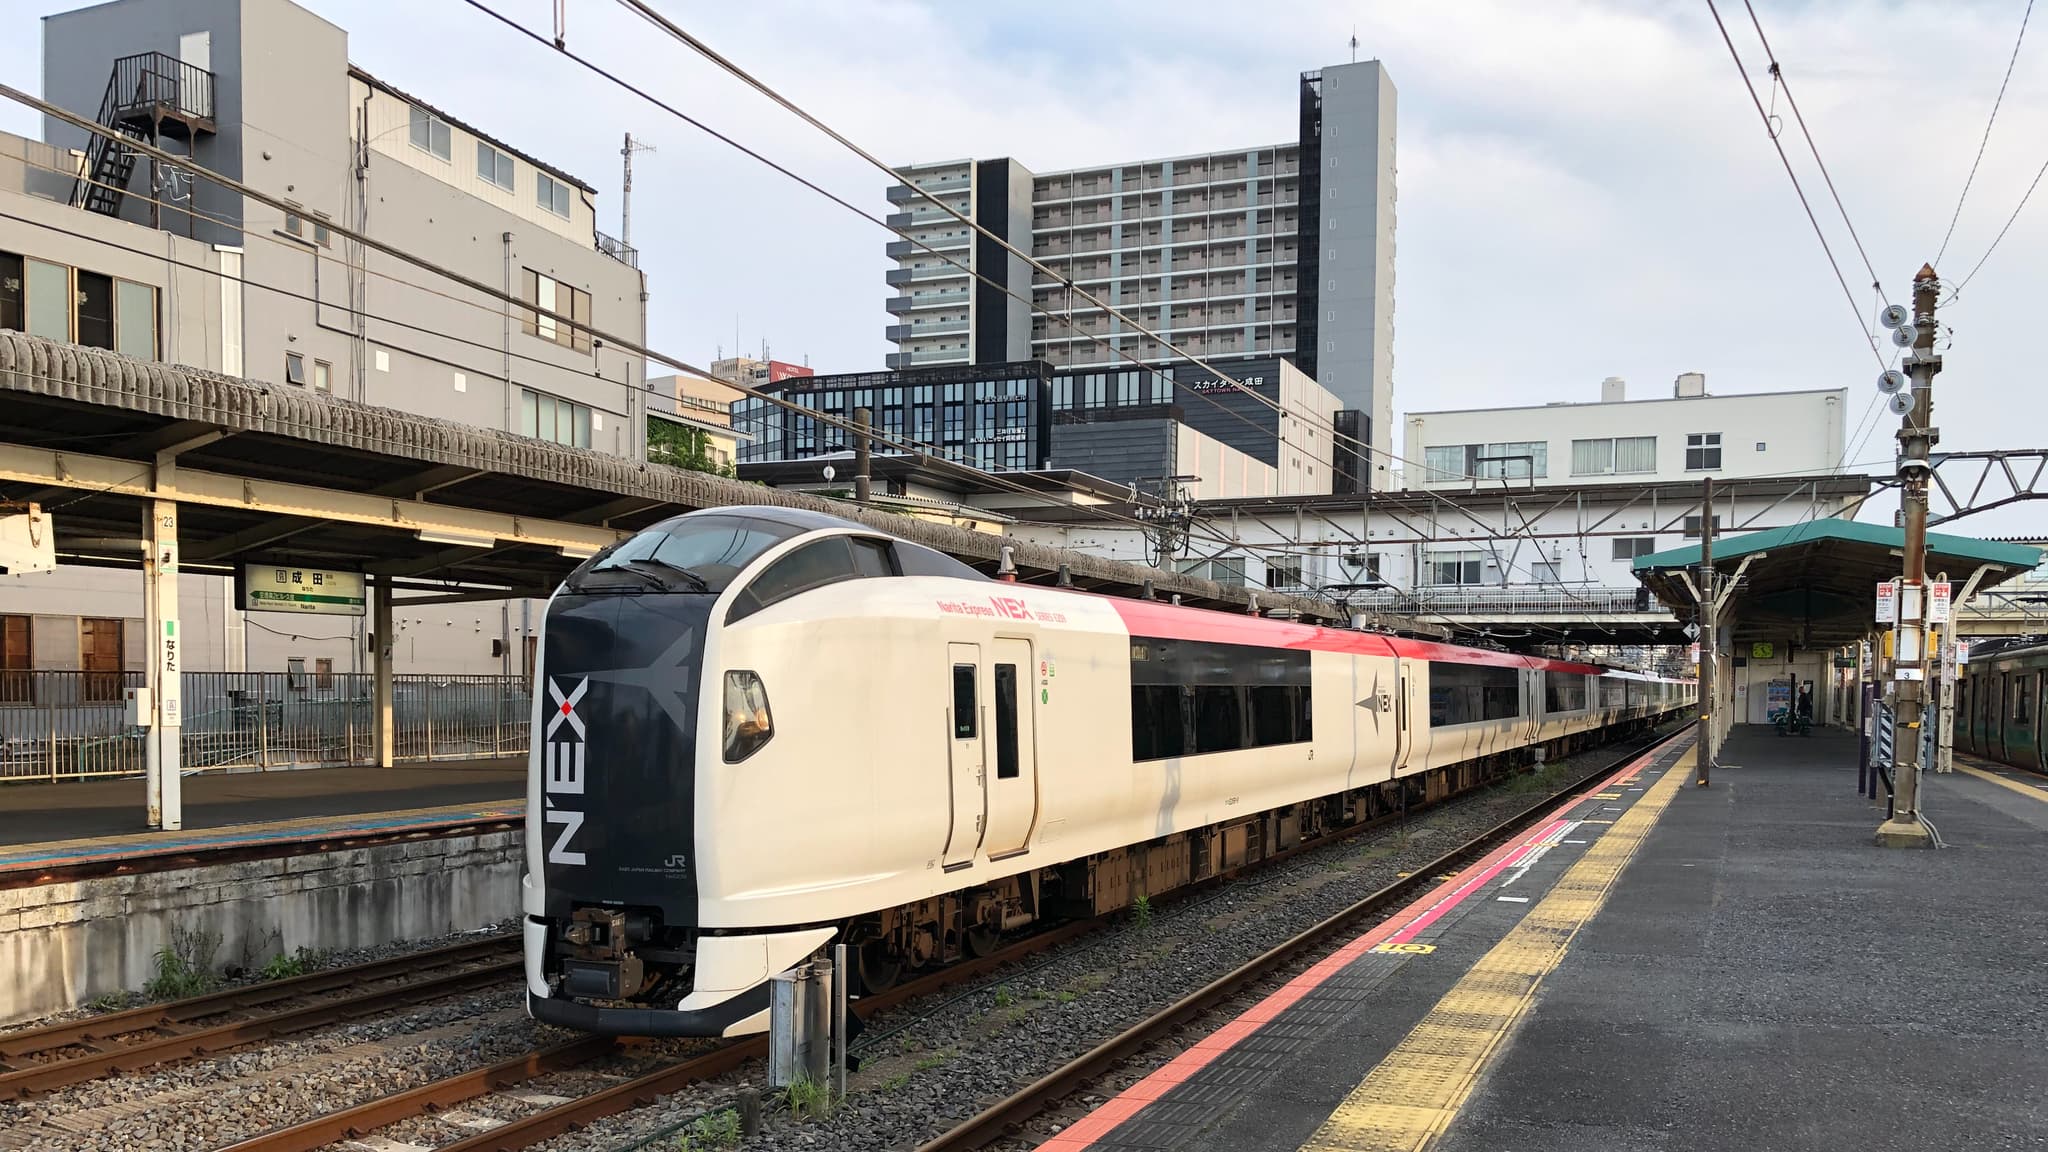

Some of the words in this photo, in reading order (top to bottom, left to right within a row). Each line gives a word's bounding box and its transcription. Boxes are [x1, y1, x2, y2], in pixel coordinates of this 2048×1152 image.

[163, 516, 174, 528] 23
[292, 570, 323, 586] 成田
[936, 600, 963, 614] Narita
[962, 602, 995, 619] Express
[166, 640, 176, 672] なりた
[1904, 672, 1910, 680] 3
[664, 854, 686, 867] JR
